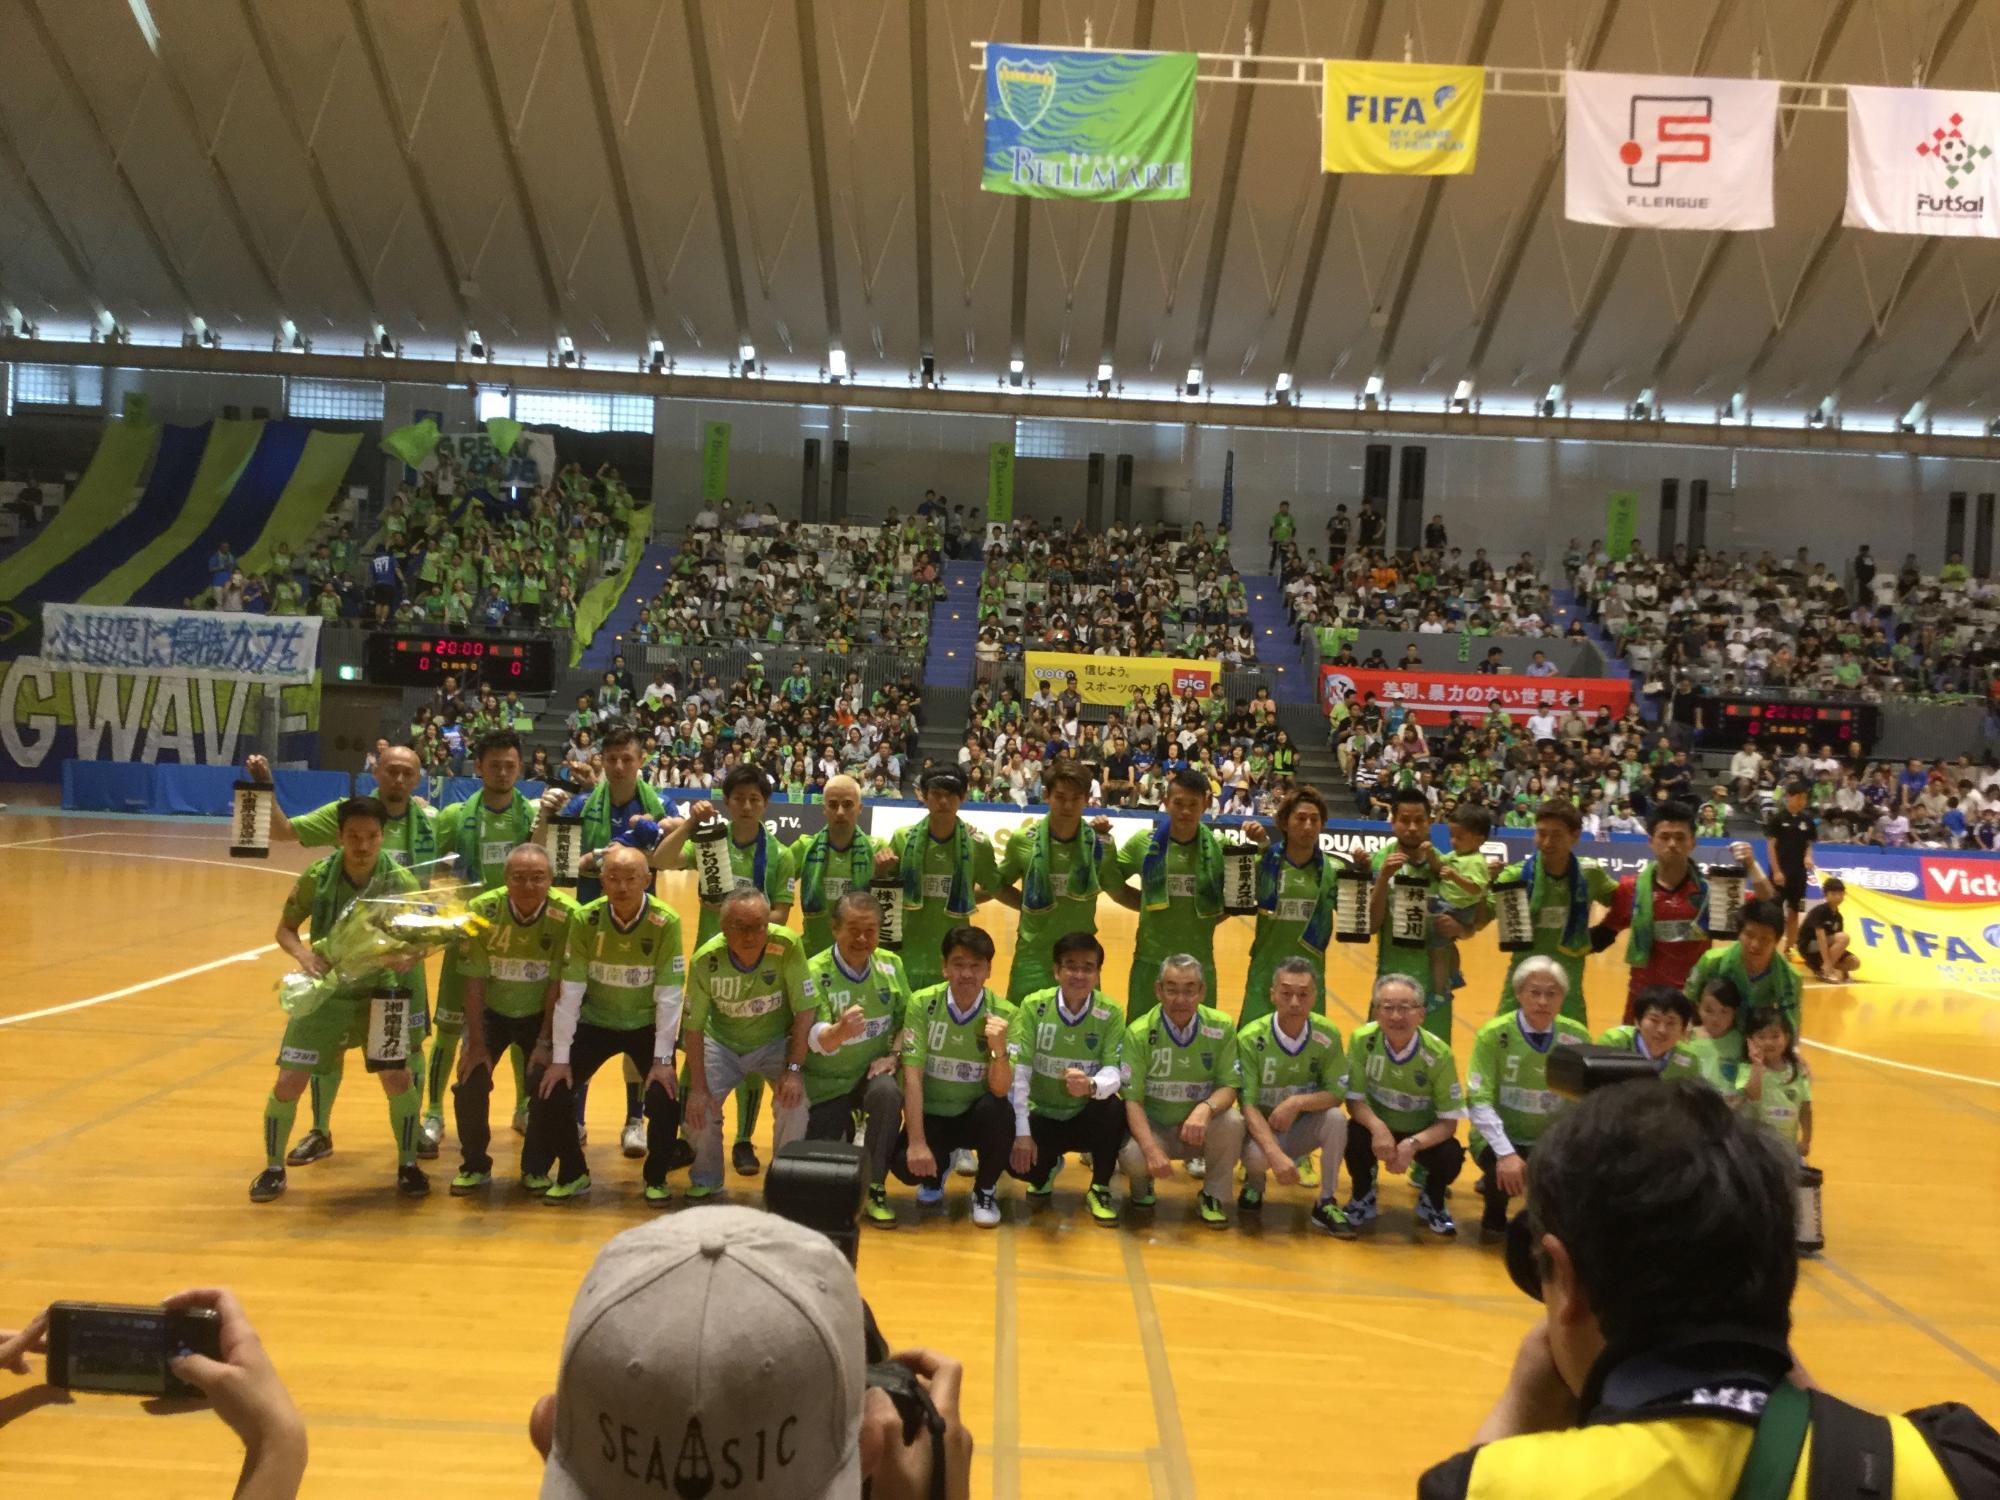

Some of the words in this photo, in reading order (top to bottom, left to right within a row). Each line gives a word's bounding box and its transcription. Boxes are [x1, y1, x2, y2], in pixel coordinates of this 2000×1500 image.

[1346, 94, 1426, 125] FIFA
[1626, 196, 1709, 209] F.LEAGUE
[1084, 664, 1130, 679] 信じよう。
[1860, 917, 1987, 964] FIFA
[1151, 1048, 1171, 1077] 29
[1263, 1057, 1276, 1084] 6
[1505, 1055, 1520, 1082] 5
